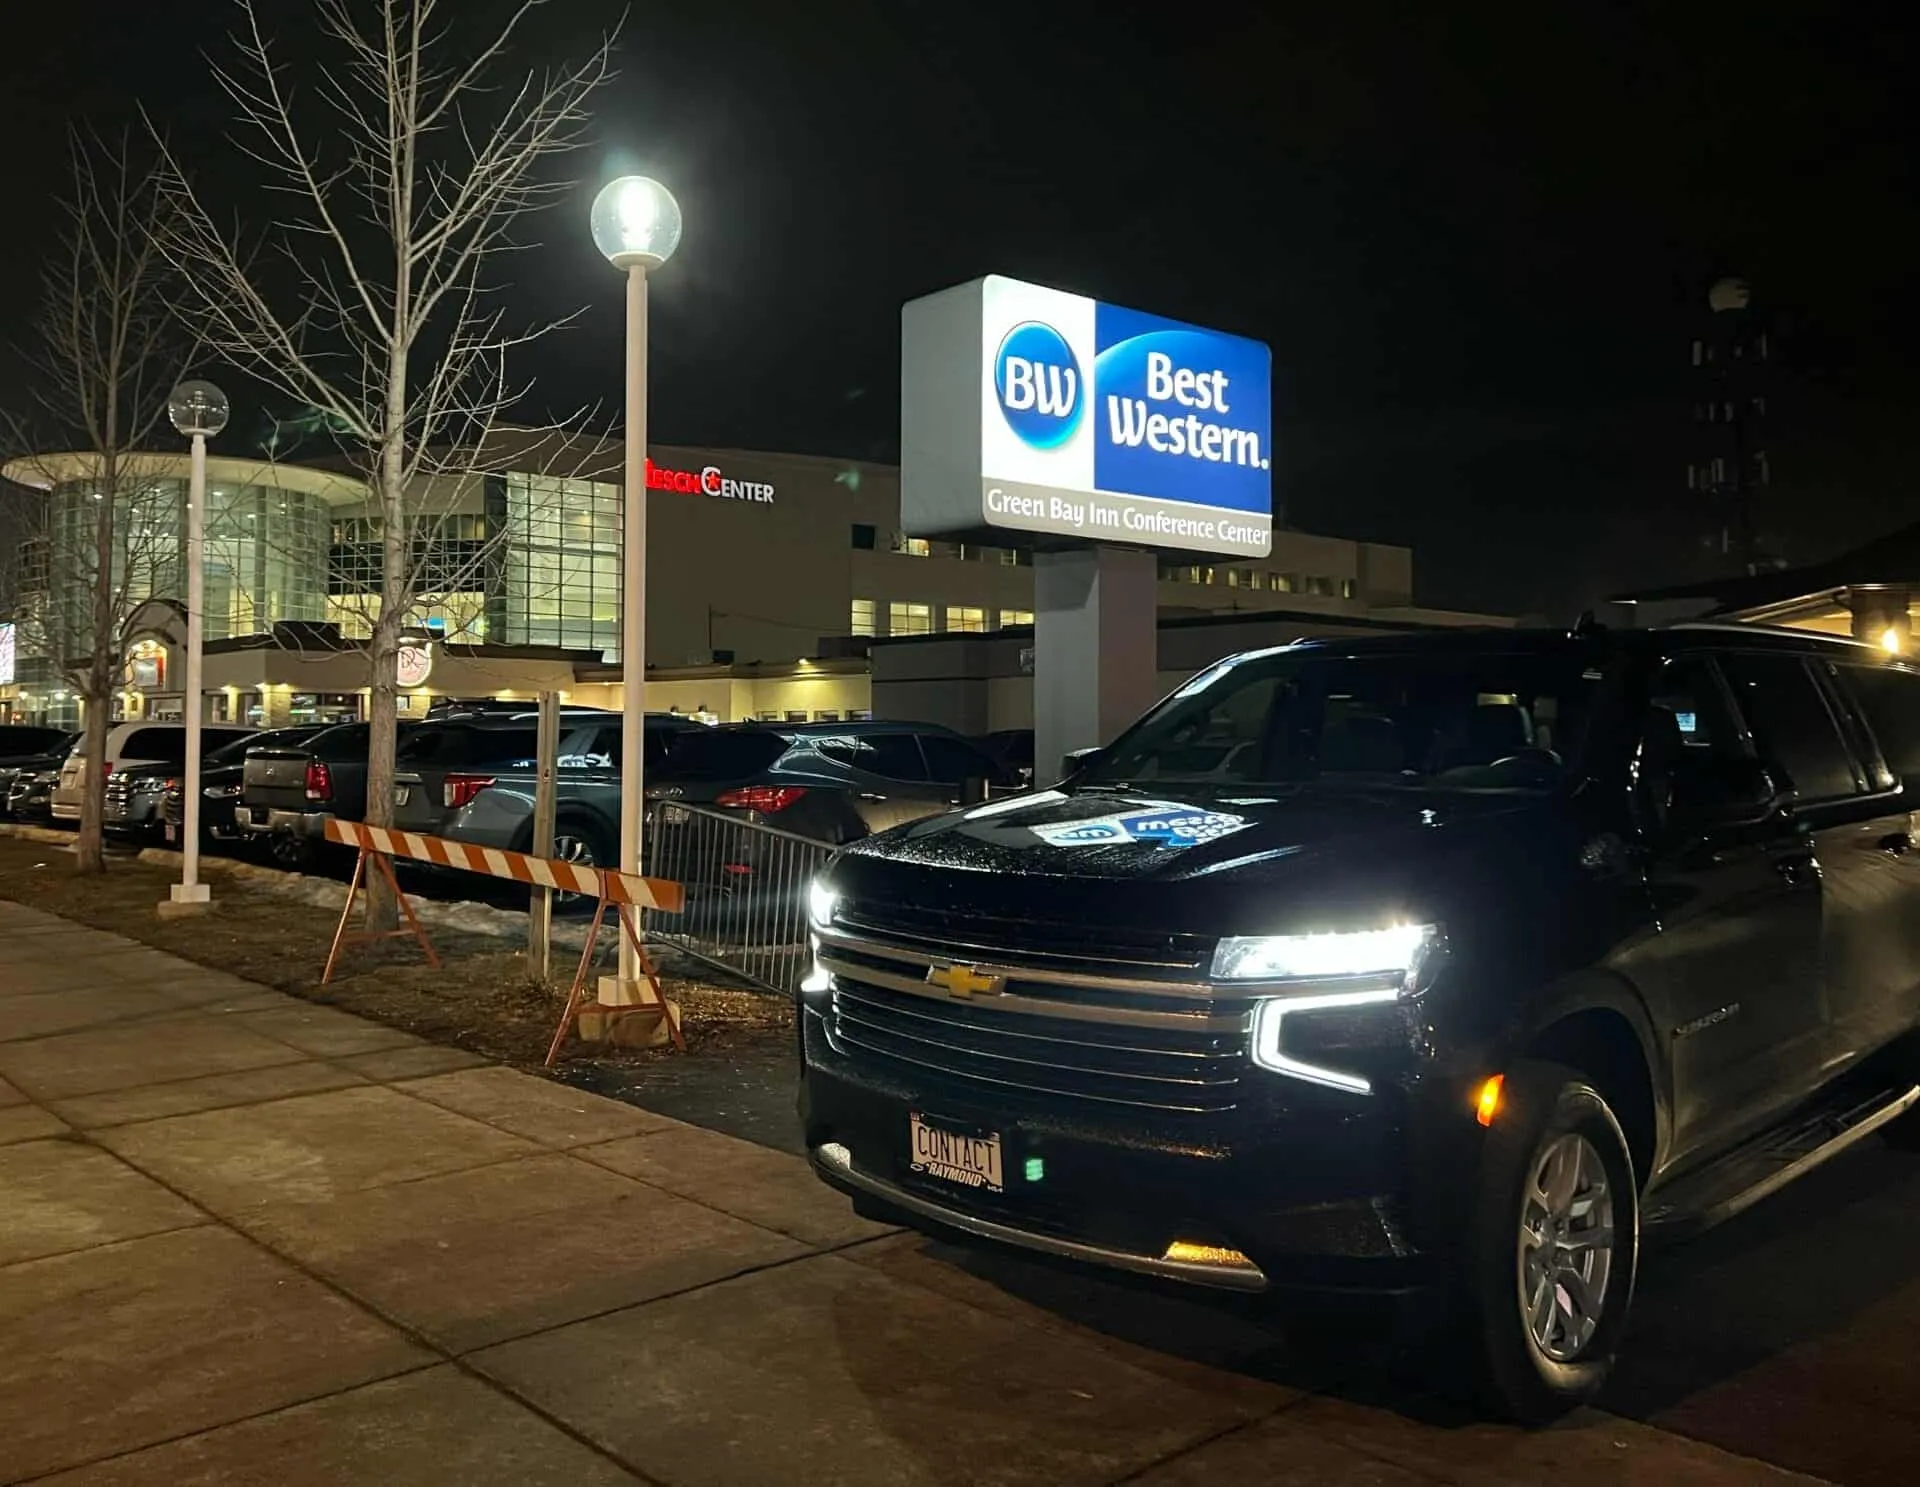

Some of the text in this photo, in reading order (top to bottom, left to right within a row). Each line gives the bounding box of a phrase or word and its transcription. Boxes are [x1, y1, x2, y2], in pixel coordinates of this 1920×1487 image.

[1004, 356, 1076, 418] BW
[1147, 352, 1229, 414] Best
[701, 466, 774, 504] CENTER
[987, 488, 1270, 545] Green Bay Inn Conference Center
[917, 1126, 995, 1175] CONTACT
[927, 1162, 983, 1188] RAYMOND
